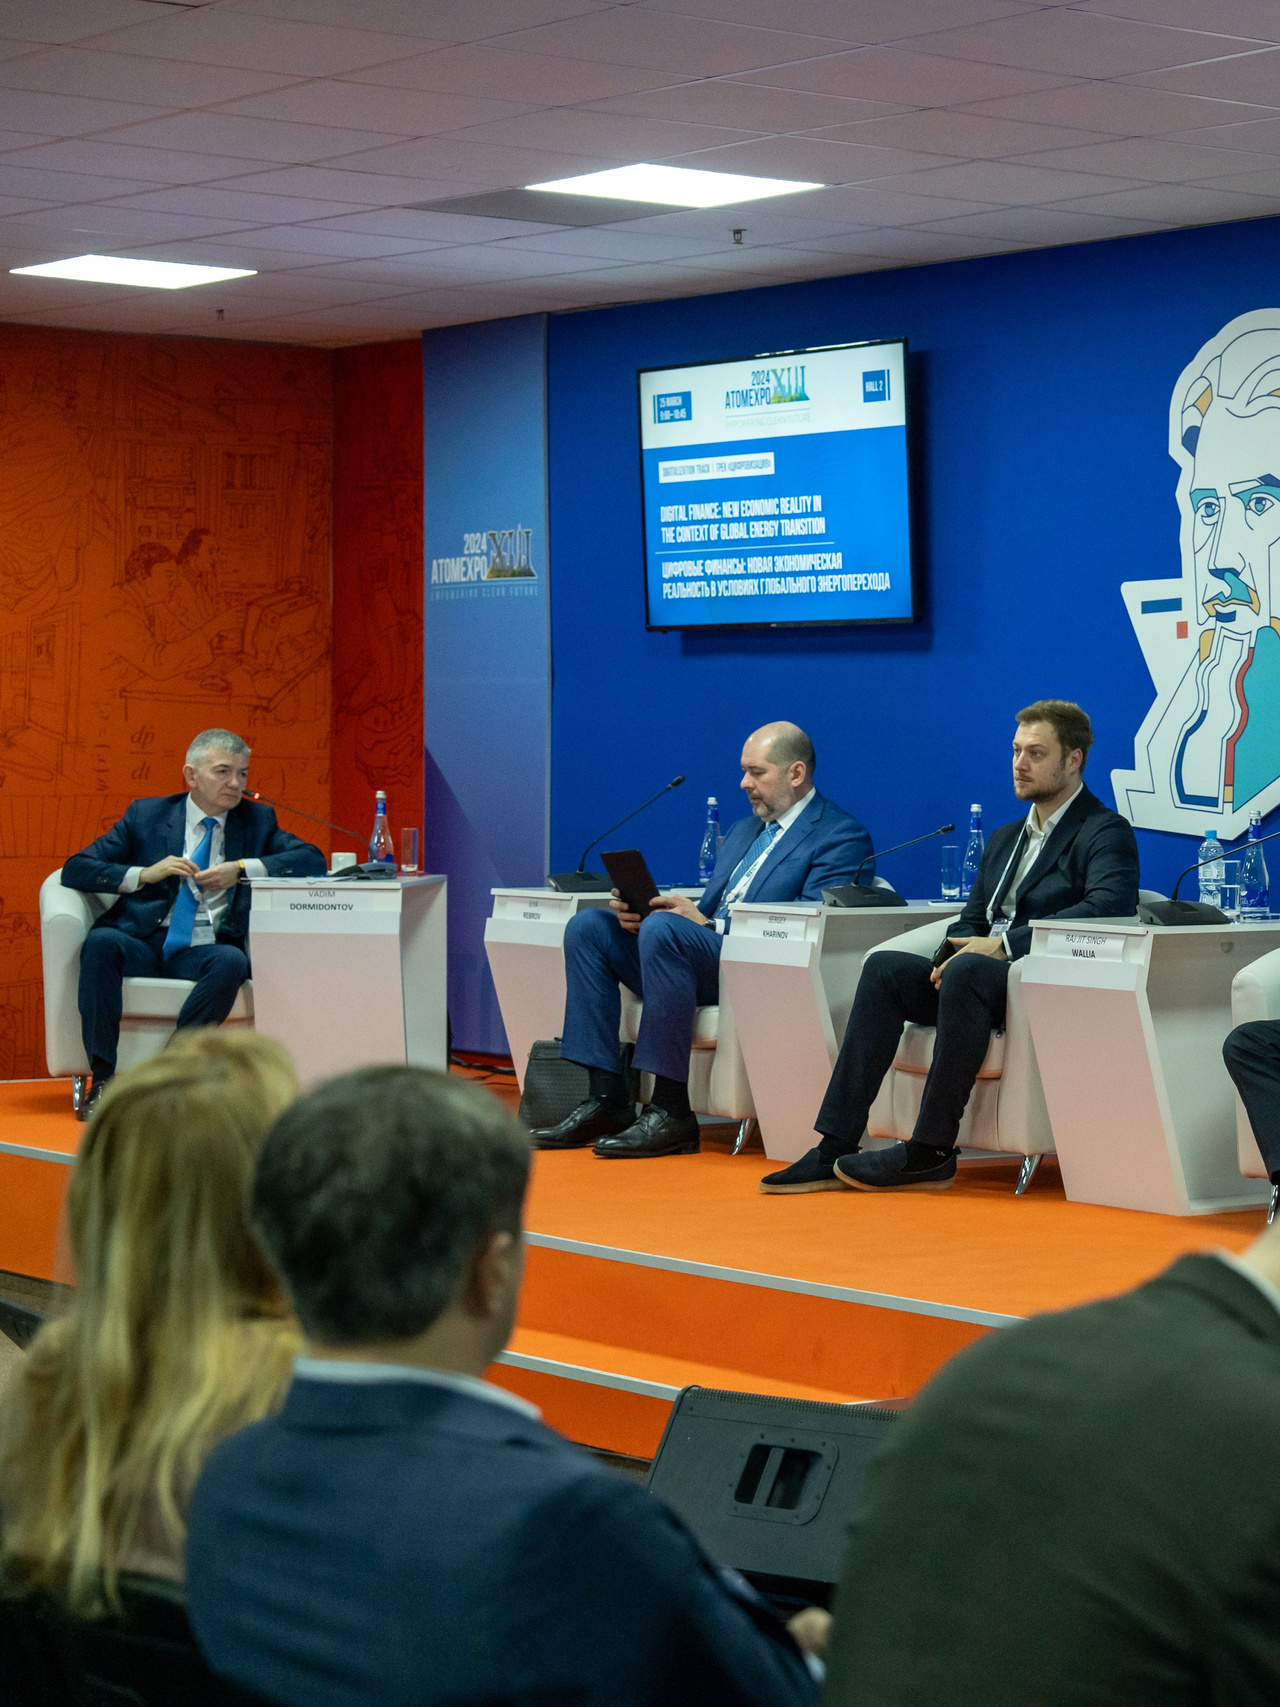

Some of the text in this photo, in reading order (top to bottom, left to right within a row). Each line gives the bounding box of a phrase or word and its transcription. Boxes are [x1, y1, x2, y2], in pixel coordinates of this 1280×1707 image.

[751, 370, 770, 386] 2024
[865, 380, 883, 393] HALL 2
[725, 387, 771, 409] ATOMEXPO
[661, 495, 822, 523] DIGITAL FINANCE: NEW ECONOMIC REALITY IN
[661, 517, 826, 543] THE CONTEXT OF GLOBAL ENERGY TRANSITION
[463, 532, 487, 554] 2024
[431, 555, 487, 584] ATOMEXPO
[662, 560, 704, 579] ЦИФРОВЫЕ
[747, 556, 773, 574] НОВАЯ
[774, 552, 842, 573] ЭКОНОМИЧЕСКАЯ
[663, 572, 890, 599] РЕАЛЬНОСТЬ В УСЛОВИЯХ ГЛОБАЛЬНОГО ЭНЕРГОПЕРЕХОДА
[308, 890, 336, 898] VADIM
[290, 903, 354, 911] DORMIDONTOV
[768, 915, 787, 924] SERGEY
[762, 930, 788, 939] KHARINOV
